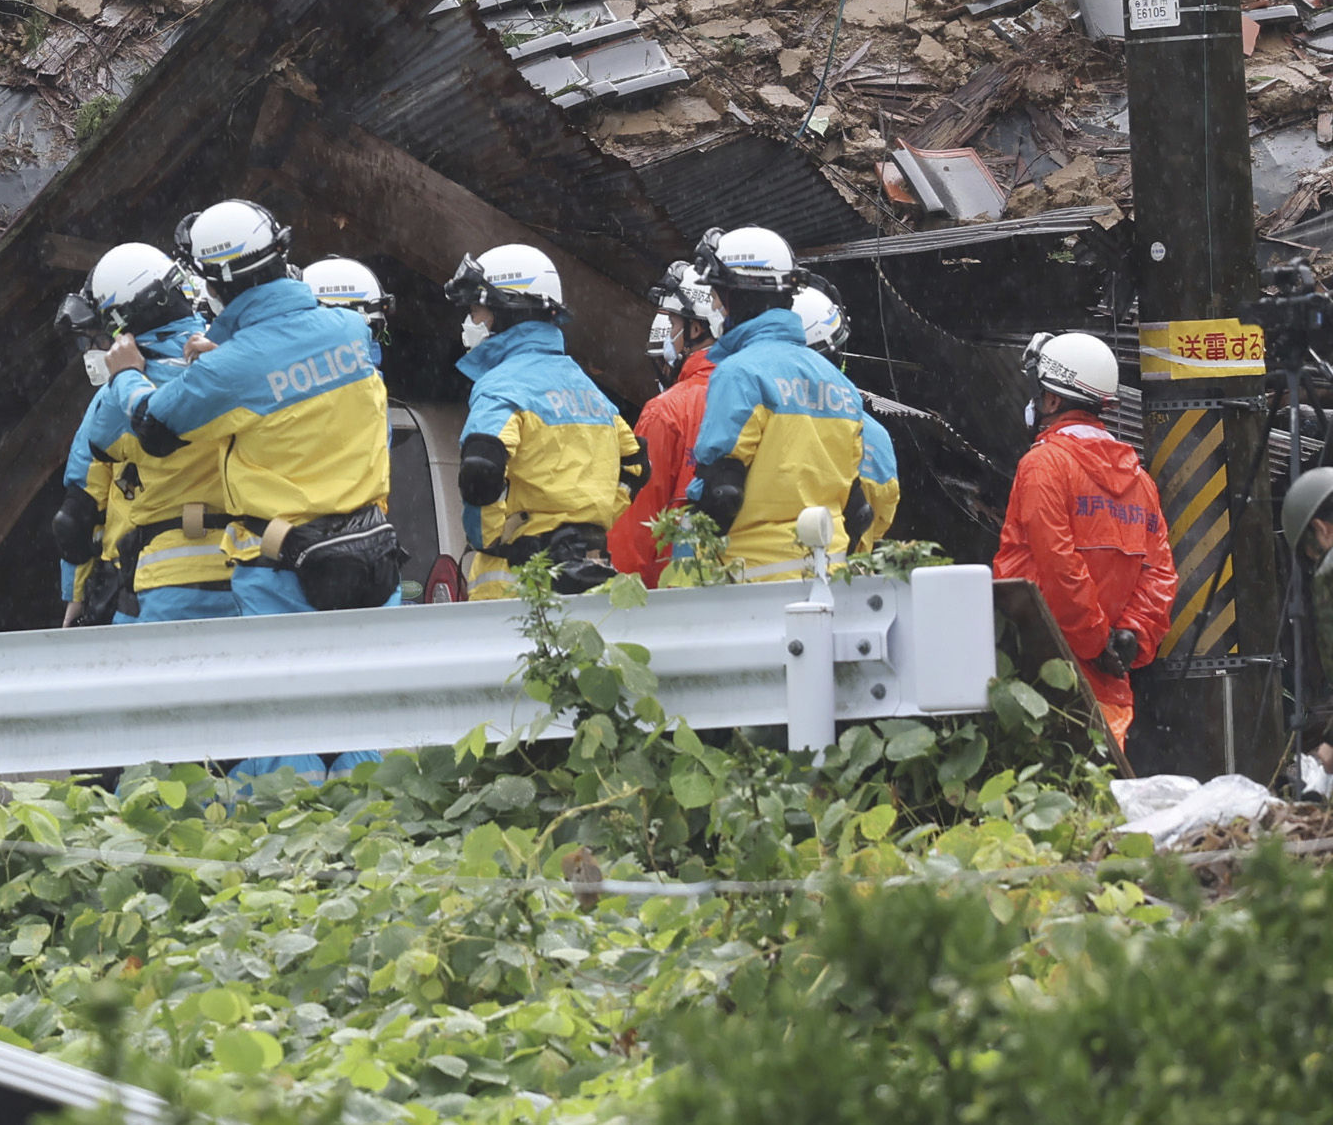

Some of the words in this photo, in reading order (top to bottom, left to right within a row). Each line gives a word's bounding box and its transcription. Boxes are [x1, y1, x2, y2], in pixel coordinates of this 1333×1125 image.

[1137, 7, 1166, 20] E6105
[267, 340, 374, 403] POLICE
[776, 378, 858, 415] POLICE
